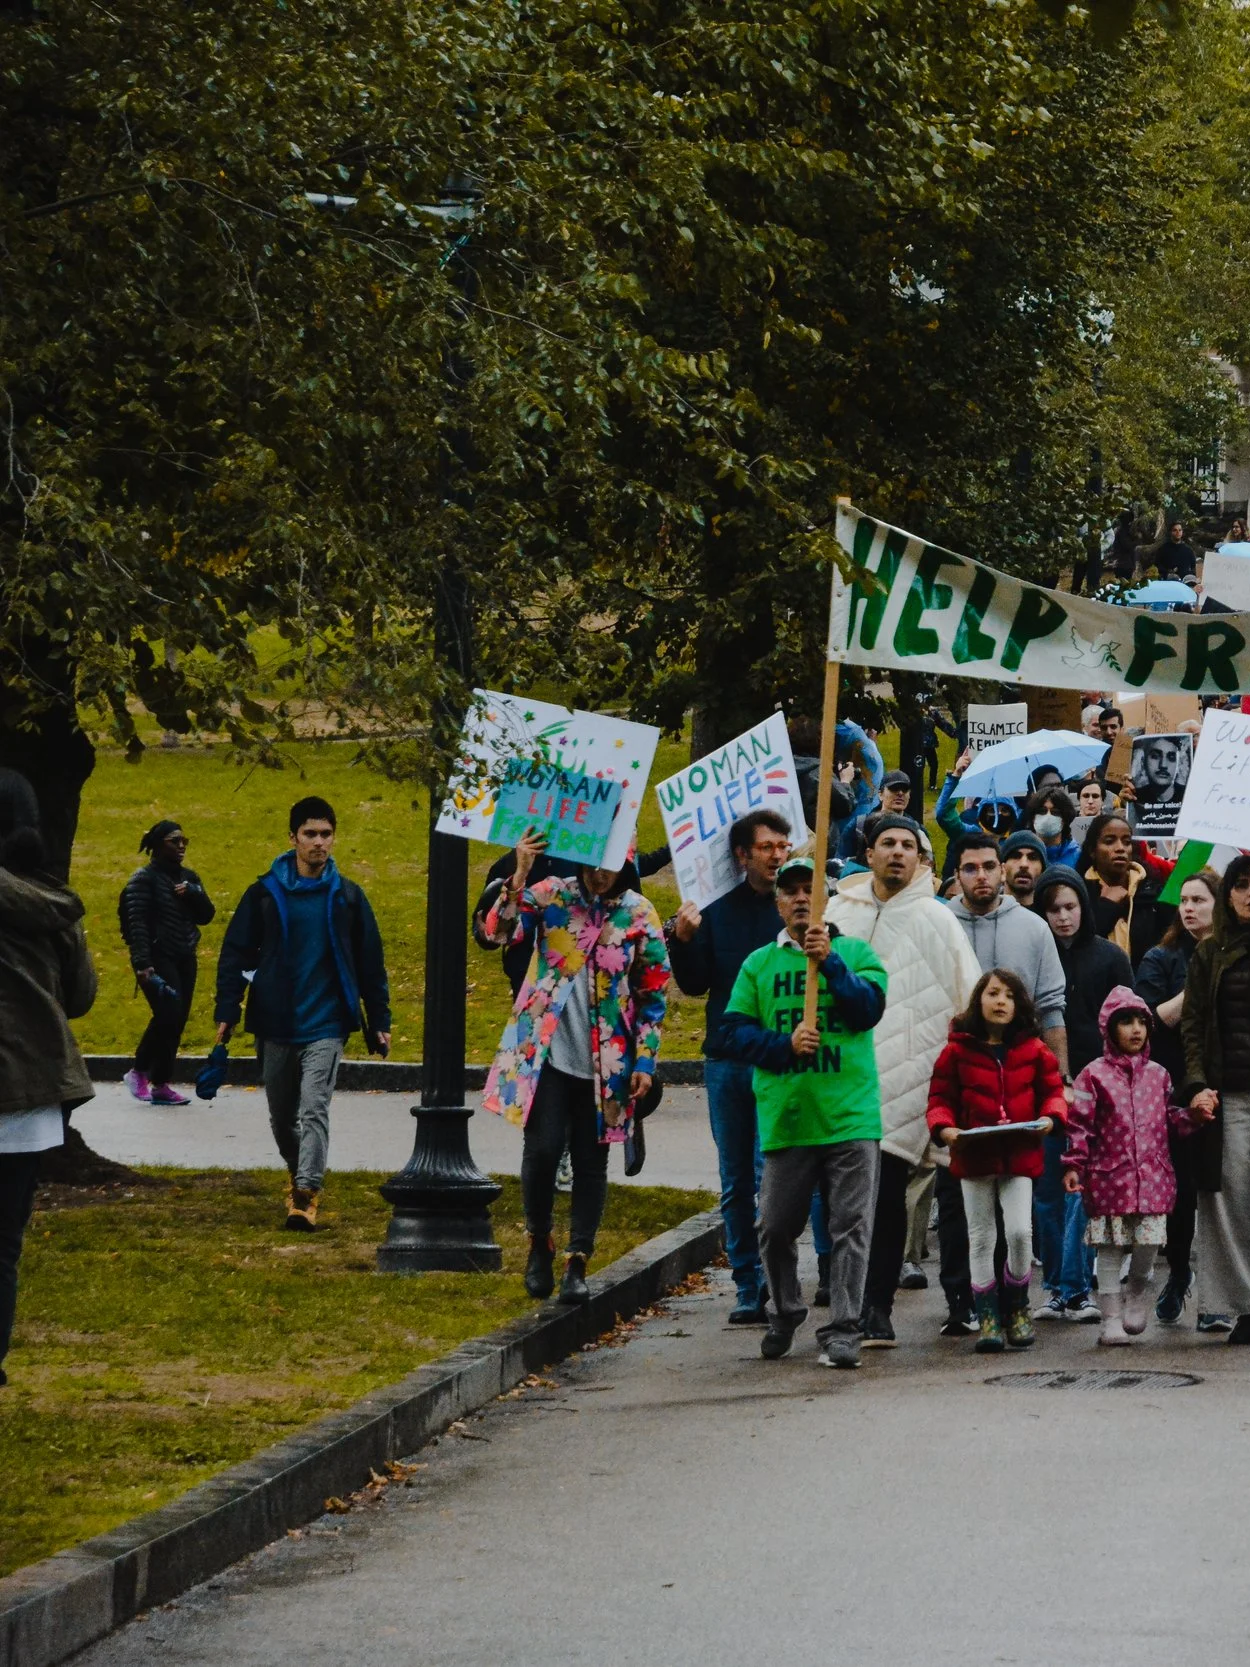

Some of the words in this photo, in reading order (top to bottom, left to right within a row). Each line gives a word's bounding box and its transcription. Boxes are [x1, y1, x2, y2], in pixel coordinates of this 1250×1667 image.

[847, 516, 1068, 672] HELP
[968, 721, 1024, 735] ISLAMIC
[506, 763, 613, 803] WOMAN
[659, 725, 772, 812] WOMAN
[527, 792, 590, 824] LIFE
[696, 767, 763, 842] LIFE
